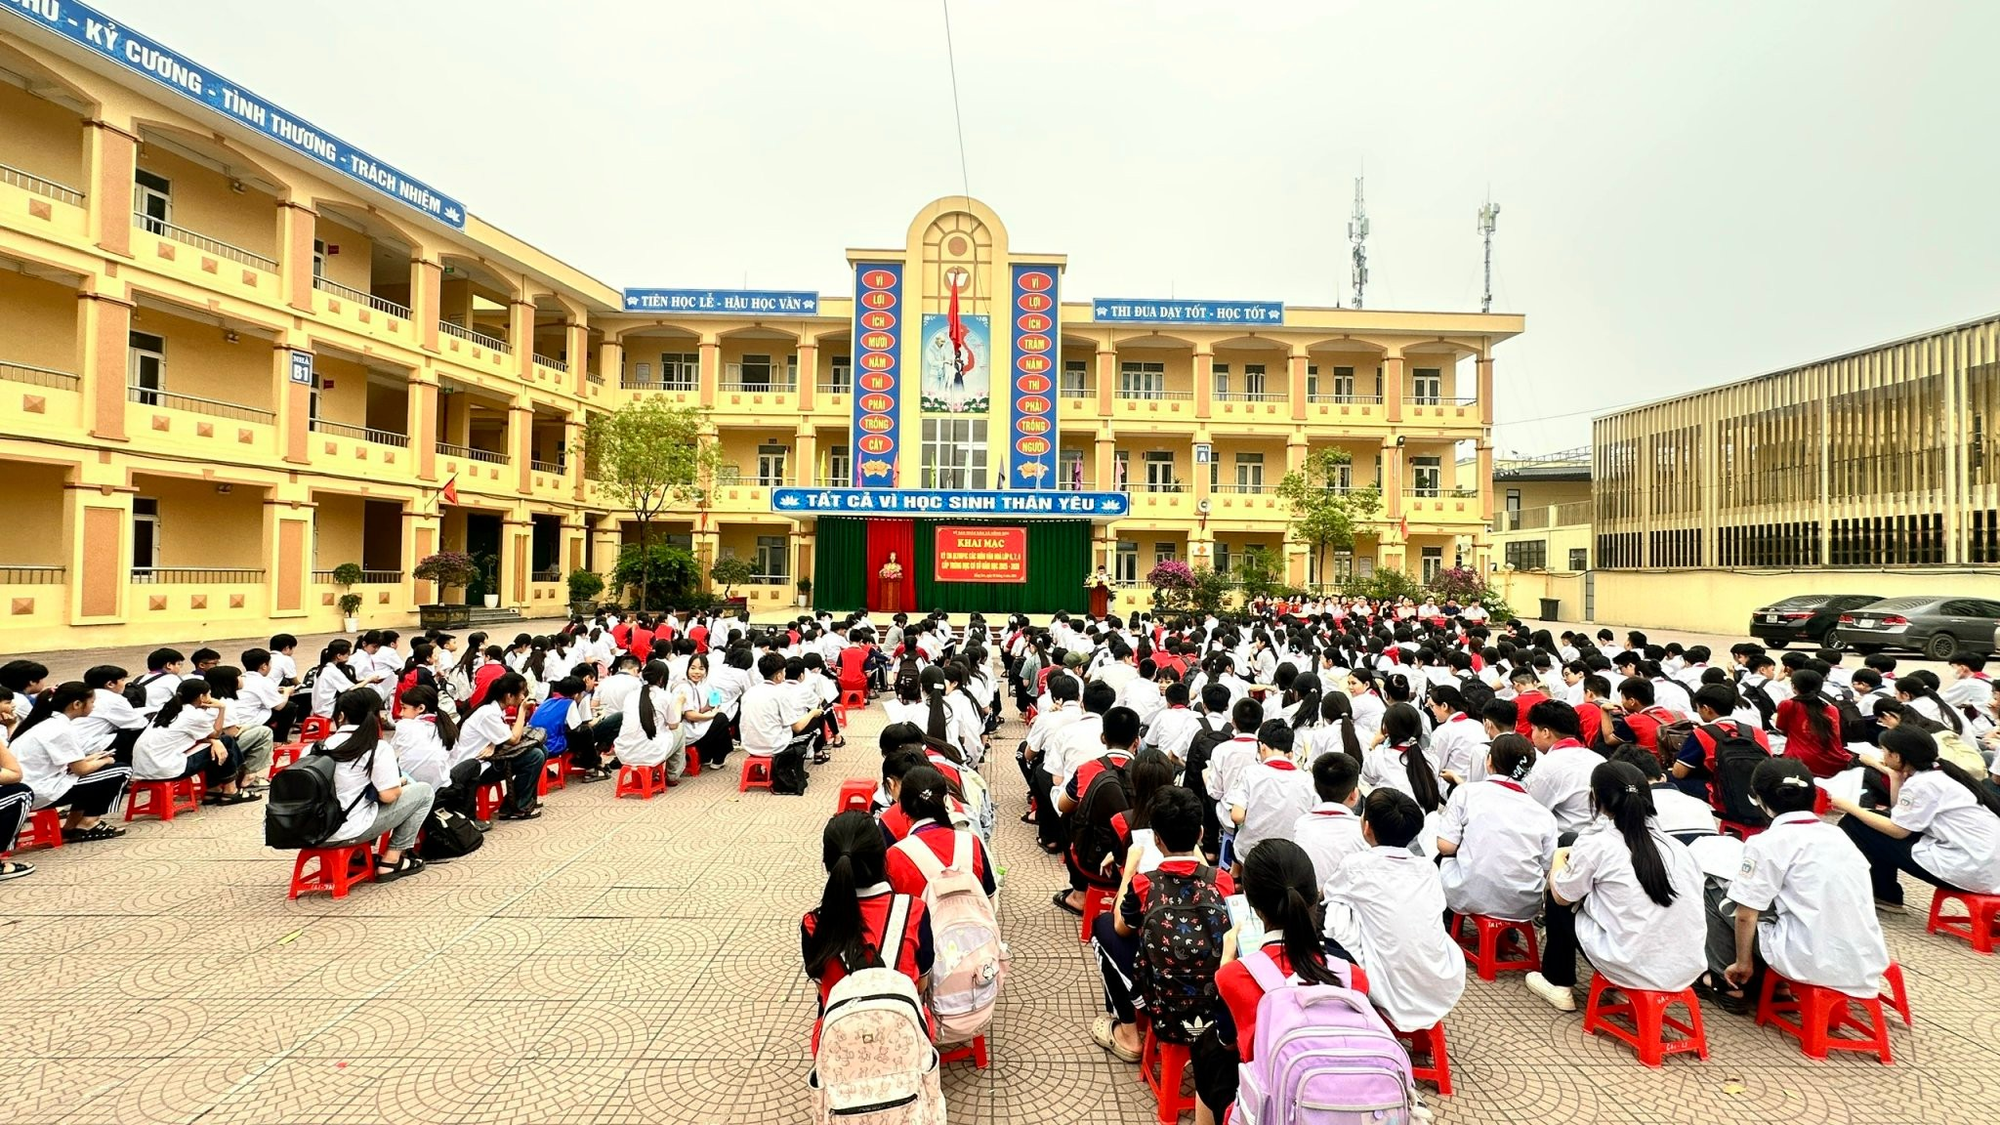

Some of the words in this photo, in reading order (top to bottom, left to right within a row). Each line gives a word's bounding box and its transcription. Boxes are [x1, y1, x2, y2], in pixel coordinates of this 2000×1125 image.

[85, 17, 119, 51] KỶ
[125, 38, 203, 95] CƯƠNG
[222, 87, 266, 127] TÌNH
[270, 112, 337, 163] THƯƠNG
[350, 153, 397, 193] TRÁCH
[399, 181, 442, 216] NHIỆM
[876, 274, 883, 287] VÌ
[1031, 276, 1039, 289] VÌ
[641, 293, 668, 307] TIÊN
[671, 297, 696, 310] HỌC
[725, 295, 749, 310] HẬU
[751, 298, 777, 311] HỌC
[779, 296, 802, 310] VĂN
[873, 295, 885, 307] LỢI
[1029, 297, 1041, 309] LỢI
[1111, 305, 1131, 317] THI
[1134, 306, 1157, 318] ĐUA
[1160, 307, 1182, 320] DẠY
[1185, 303, 1207, 319] TỐT
[1217, 307, 1241, 321] HỌC
[1245, 305, 1266, 319] TỐT
[872, 315, 885, 327] ÍCH
[1028, 317, 1041, 329] ÍCH
[868, 335, 888, 348] MƯỜI
[294, 364, 309, 381] B1
[868, 397, 886, 410] PHẢI
[1025, 399, 1042, 412] PHẢI
[1022, 440, 1045, 453] NGƯỜI
[807, 490, 840, 507] TẤT
[847, 491, 872, 508] CẢ
[879, 492, 897, 509] VÌ
[903, 496, 942, 512] HỌC
[949, 496, 995, 509] SINH
[1004, 492, 1053, 510] THÂN
[1058, 494, 1095, 510] YÊU
[957, 538, 982, 548] KHAI
[983, 539, 1005, 549] MẠC
